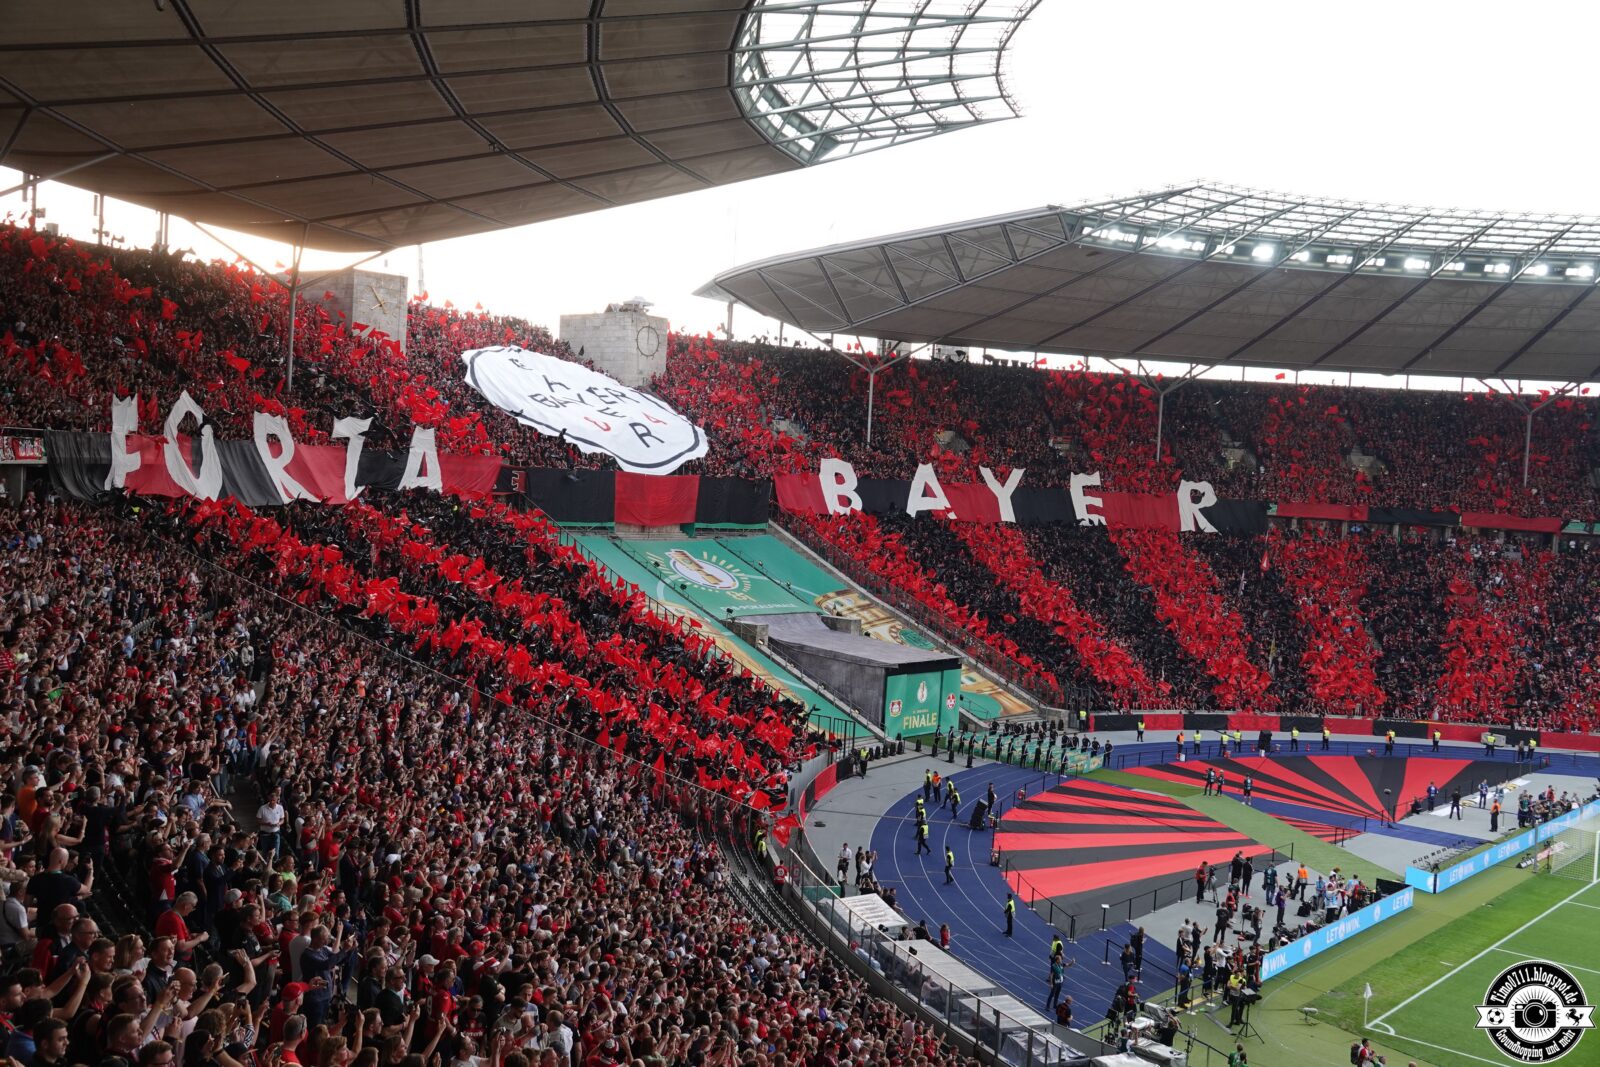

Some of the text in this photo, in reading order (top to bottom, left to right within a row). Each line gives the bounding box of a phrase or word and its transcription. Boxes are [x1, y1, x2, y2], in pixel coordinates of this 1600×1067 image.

[104, 389, 1222, 534] FORTA BAYER
[903, 712, 937, 730] FINALE
[1326, 929, 1339, 944] LET
